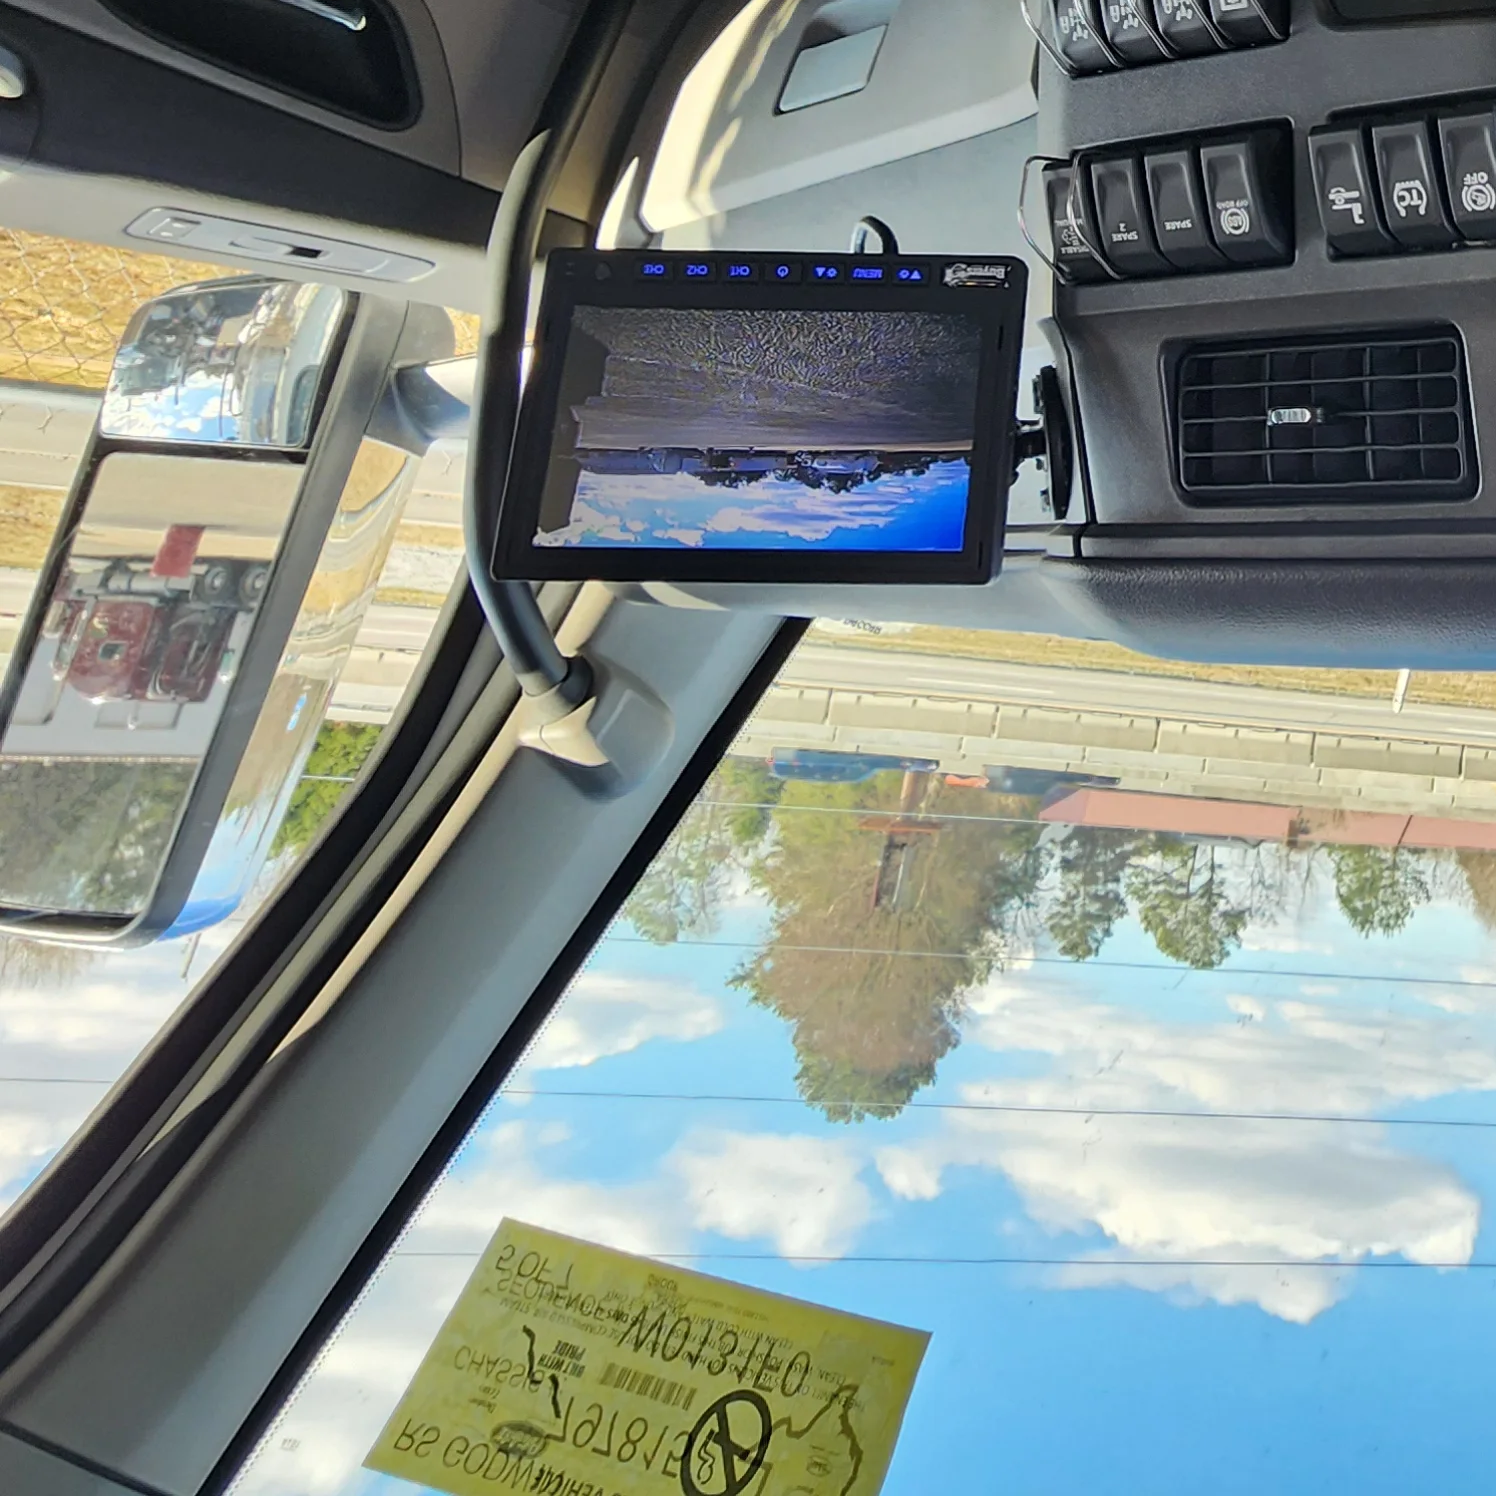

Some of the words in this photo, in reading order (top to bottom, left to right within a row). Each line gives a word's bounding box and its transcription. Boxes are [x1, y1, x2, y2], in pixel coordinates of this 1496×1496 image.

[1463, 171, 1488, 184] OFF
[1397, 189, 1422, 207] TC
[1164, 218, 1192, 231] SPARE
[1111, 230, 1138, 242] SPARE
[686, 264, 708, 275] CH2
[729, 265, 750, 276] CH1
[852, 268, 883, 278] MENU
[551, 1339, 587, 1363] PRIDE
[536, 1352, 566, 1375] WITH
